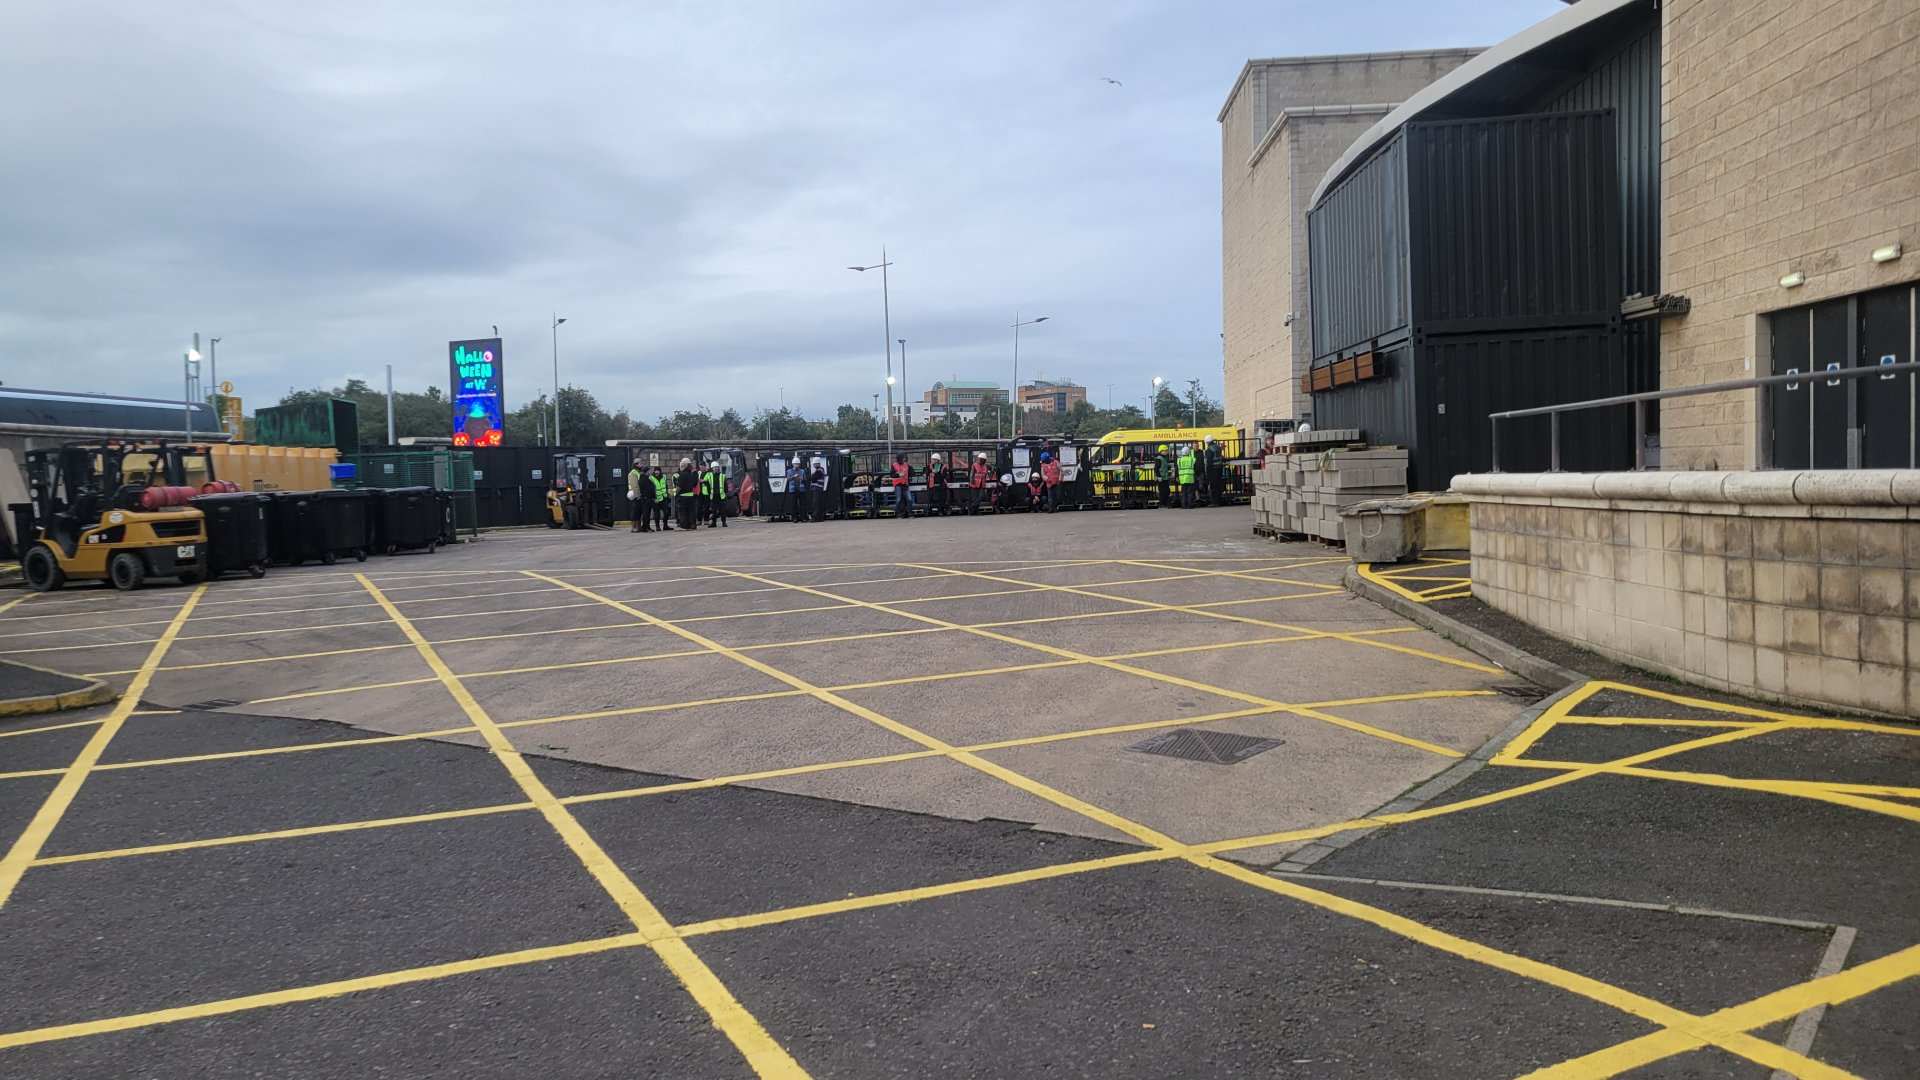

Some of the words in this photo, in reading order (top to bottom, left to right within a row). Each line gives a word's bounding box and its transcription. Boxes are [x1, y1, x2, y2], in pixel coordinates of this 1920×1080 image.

[455, 346, 493, 364] HALLO
[460, 363, 492, 378] WEEN
[1153, 431, 1198, 439] AMBULANCE
[89, 535, 100, 543] CAT
[177, 546, 196, 558] CAT
